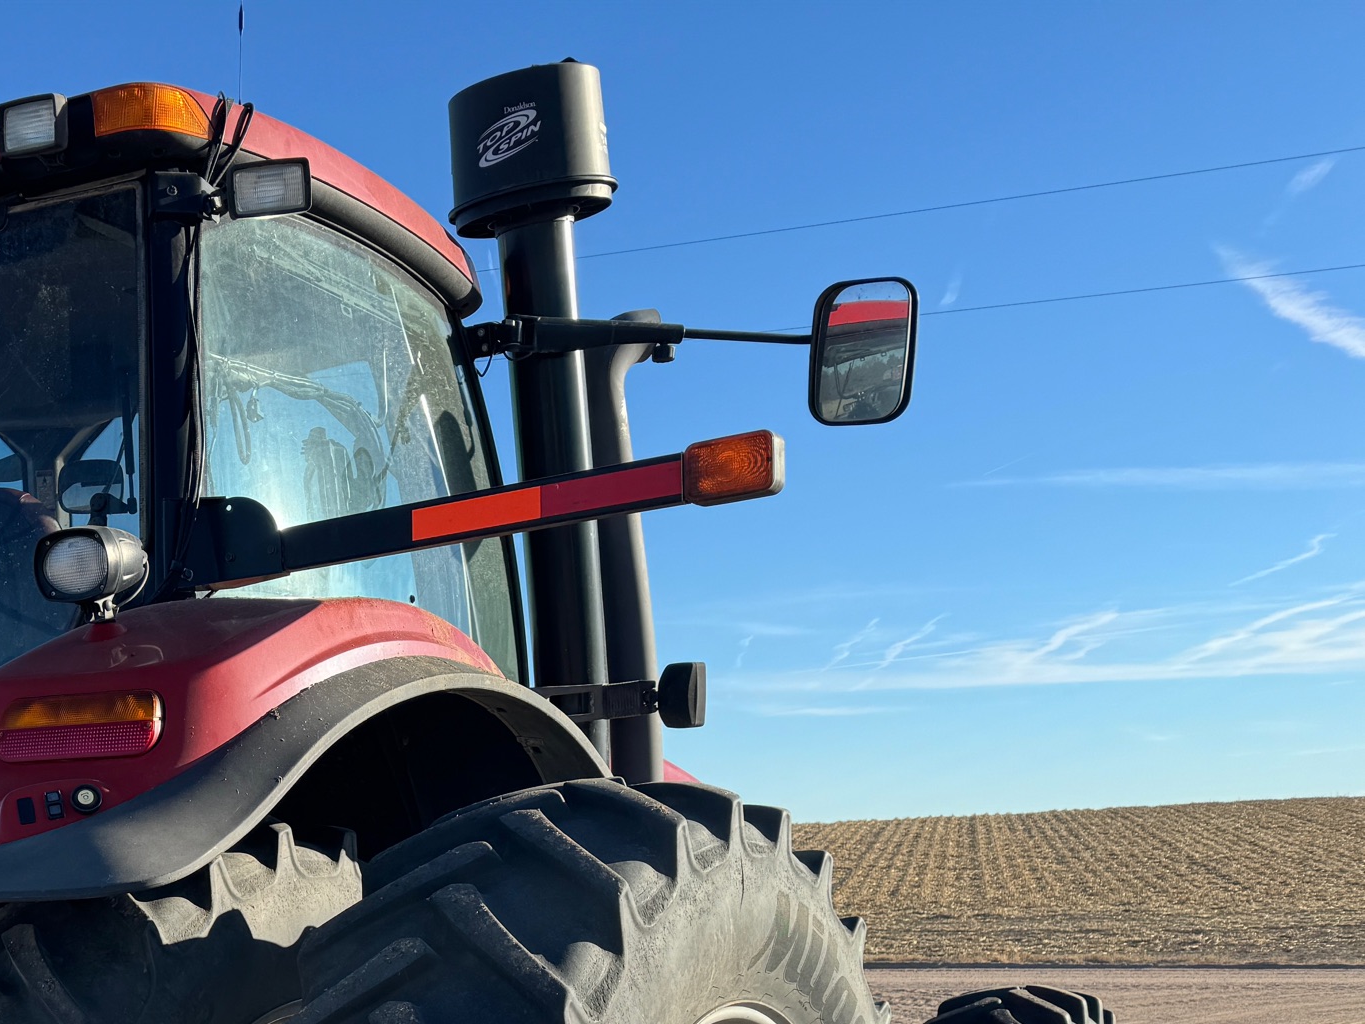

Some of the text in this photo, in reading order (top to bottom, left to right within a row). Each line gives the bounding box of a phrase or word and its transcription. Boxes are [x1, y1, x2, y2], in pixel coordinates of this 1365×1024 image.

[503, 101, 537, 114] Donaldson
[476, 121, 512, 154] TOP
[497, 120, 543, 154] SPIN
